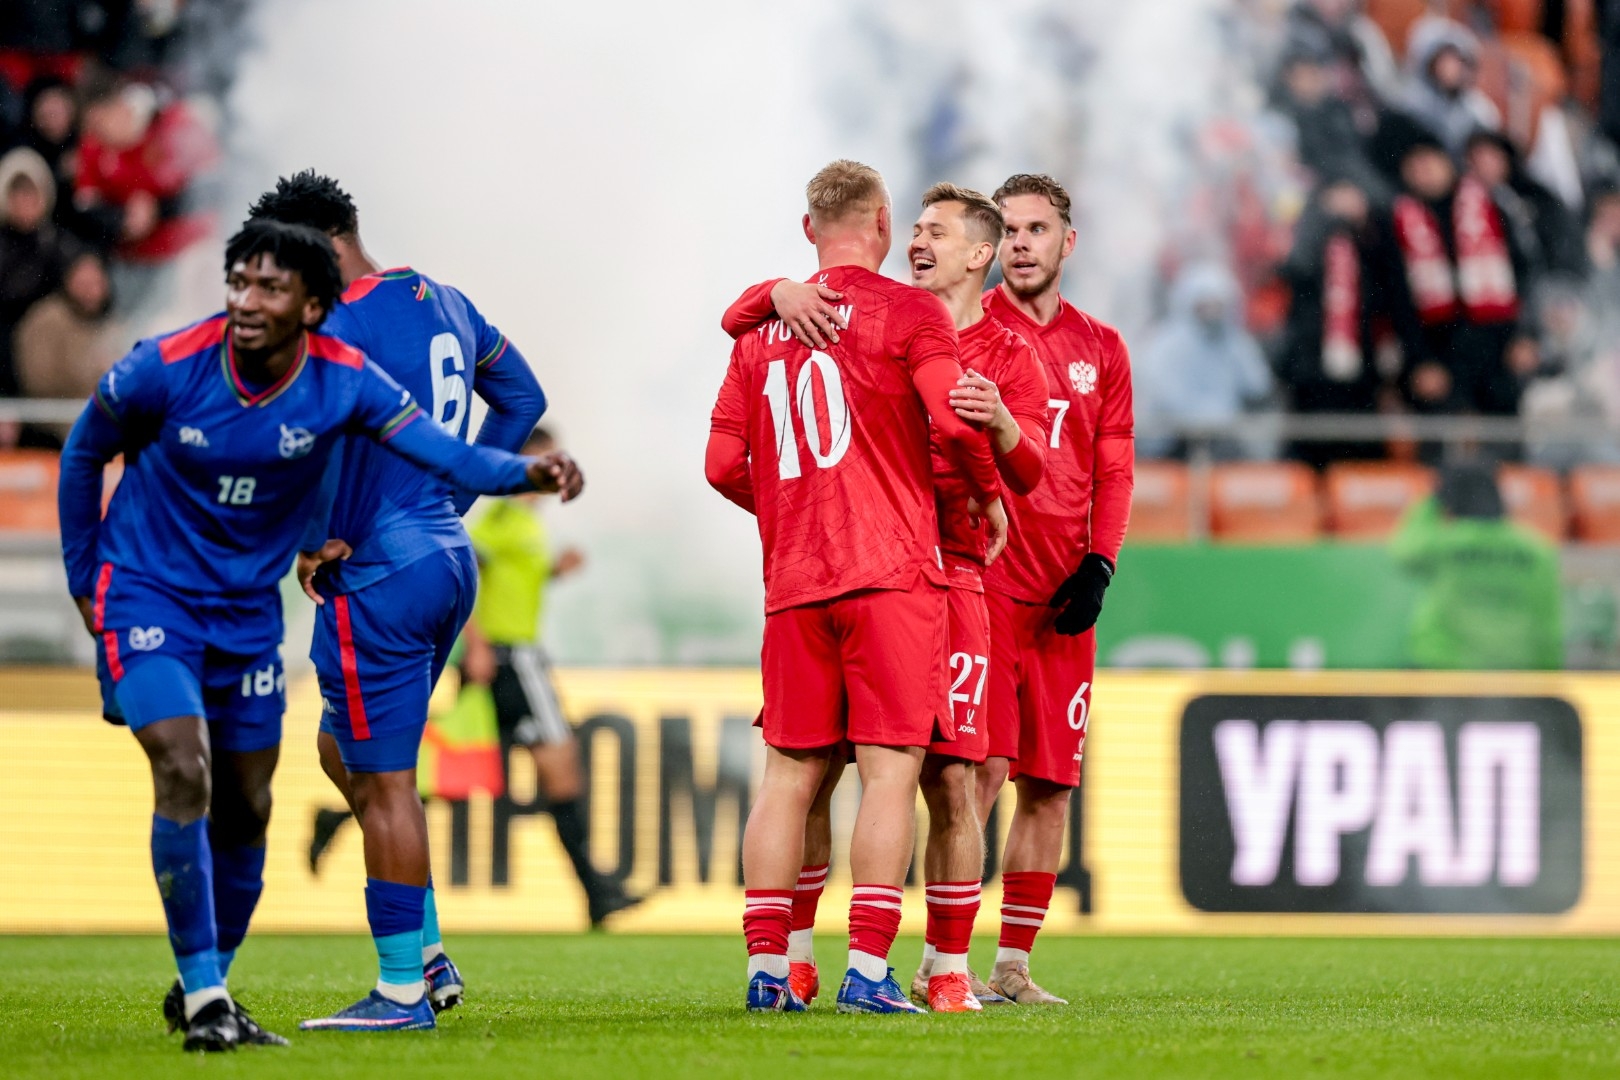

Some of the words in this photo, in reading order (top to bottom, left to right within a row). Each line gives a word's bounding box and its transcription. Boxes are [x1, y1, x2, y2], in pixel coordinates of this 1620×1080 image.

[429, 331, 467, 438] 6
[762, 349, 852, 481] 10
[217, 475, 257, 505] 18
[948, 651, 988, 706] 27
[1212, 719, 1541, 887] УРАЛ
